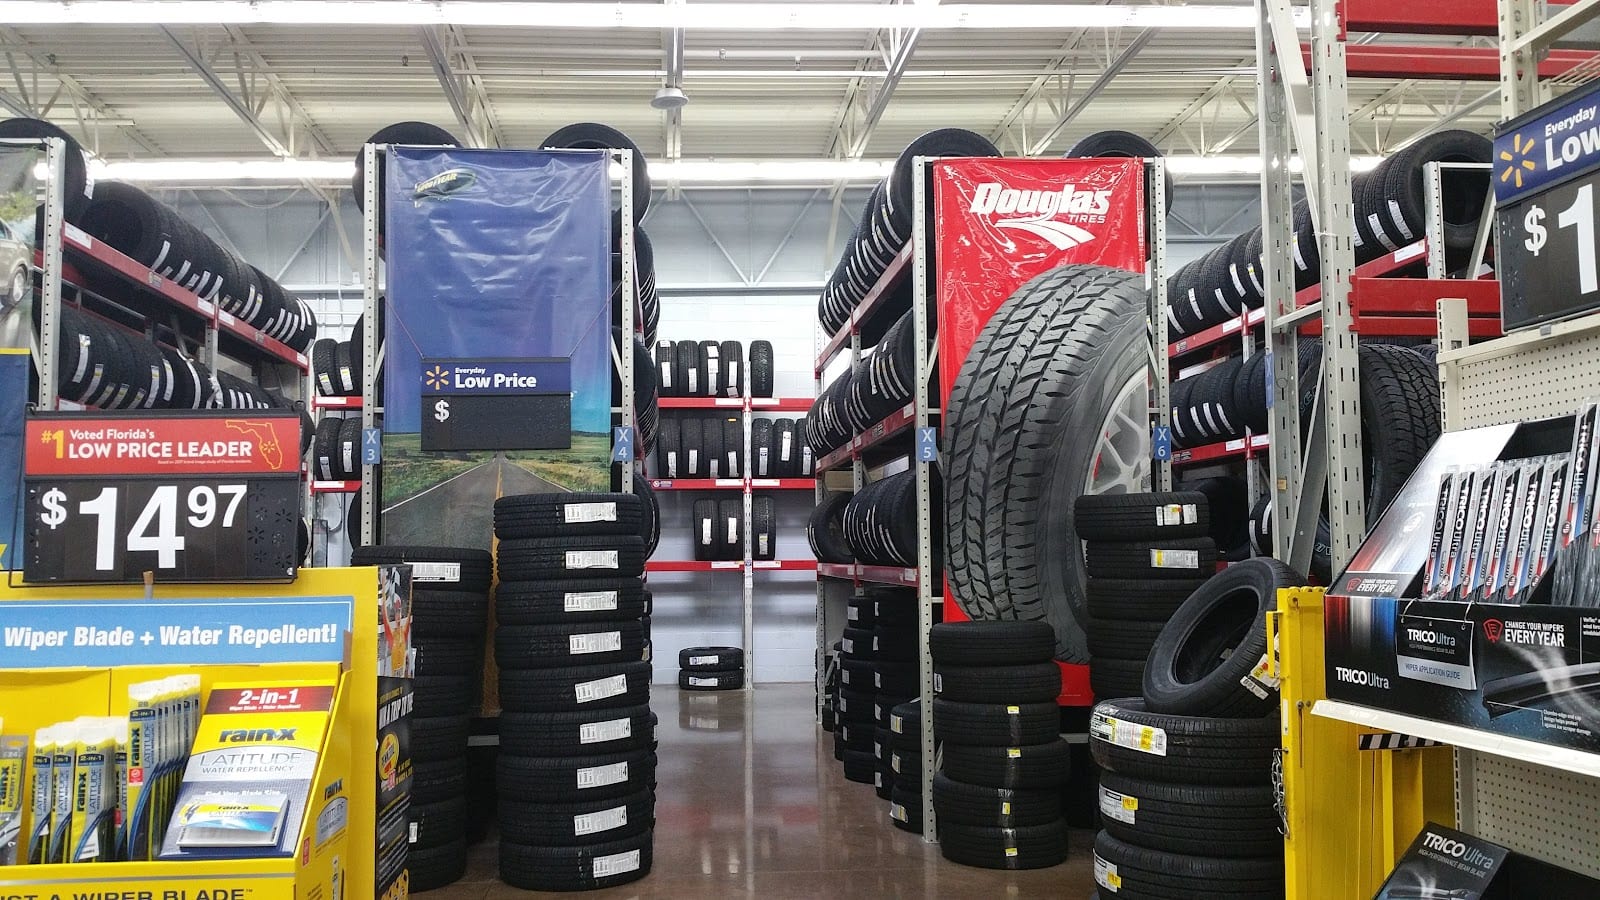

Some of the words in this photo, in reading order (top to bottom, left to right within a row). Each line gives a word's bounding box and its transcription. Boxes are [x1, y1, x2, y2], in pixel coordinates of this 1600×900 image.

[1545, 105, 1597, 137] Everyday
[969, 182, 1114, 217] Douglas
[1067, 214, 1106, 224] TIRES
[455, 367, 486, 376] Everyday
[455, 374, 491, 389] Low
[494, 373, 537, 388] Price
[434, 400, 450, 422] $
[70, 429, 103, 440] Voted
[107, 429, 155, 440] Florida's
[366, 430, 377, 444] X
[618, 429, 629, 442] X
[922, 430, 933, 442] X
[1158, 428, 1167, 441] X
[41, 430, 65, 459] #1
[69, 443, 111, 459] LOW
[117, 442, 172, 458] PRICE
[178, 441, 252, 457] LEADER
[367, 449, 375, 461] 3
[618, 446, 628, 458] 4
[923, 447, 932, 458] 5
[1158, 446, 1166, 457] 6
[1357, 583, 1377, 592] EVERY
[1505, 620, 1526, 629] CHANGE
[1527, 622, 1541, 630] YOUR
[1542, 623, 1564, 632] WIPERS
[5, 627, 68, 650] Wiper
[74, 626, 134, 646] Blade
[140, 631, 154, 645] +
[160, 625, 223, 645] Water
[229, 624, 337, 648] Repellent!
[1505, 628, 1536, 645] EVERY
[1538, 631, 1565, 647] YEAR
[238, 688, 299, 705] 2-in-1
[200, 752, 302, 767] LATITUDE
[236, 765, 295, 773] REPELLENCY
